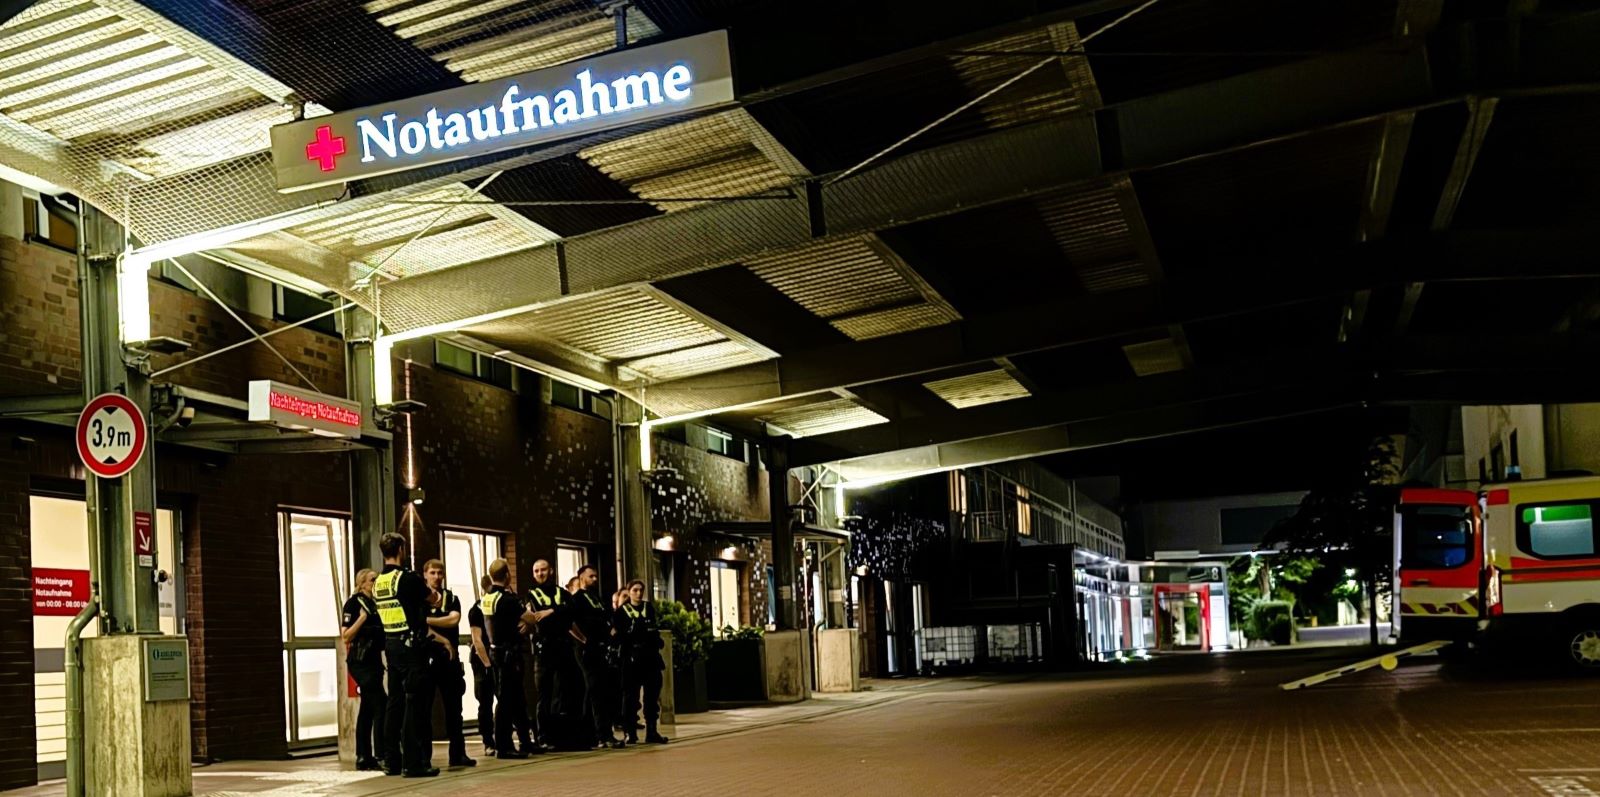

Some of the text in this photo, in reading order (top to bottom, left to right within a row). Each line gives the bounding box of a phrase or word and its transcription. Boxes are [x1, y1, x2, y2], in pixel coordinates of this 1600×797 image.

[357, 65, 692, 163] Notaufnahme
[270, 392, 359, 426] Nachteingang Notaufnahme
[35, 577, 73, 587] Nachteingang
[35, 588, 72, 597] Notaufnahme
